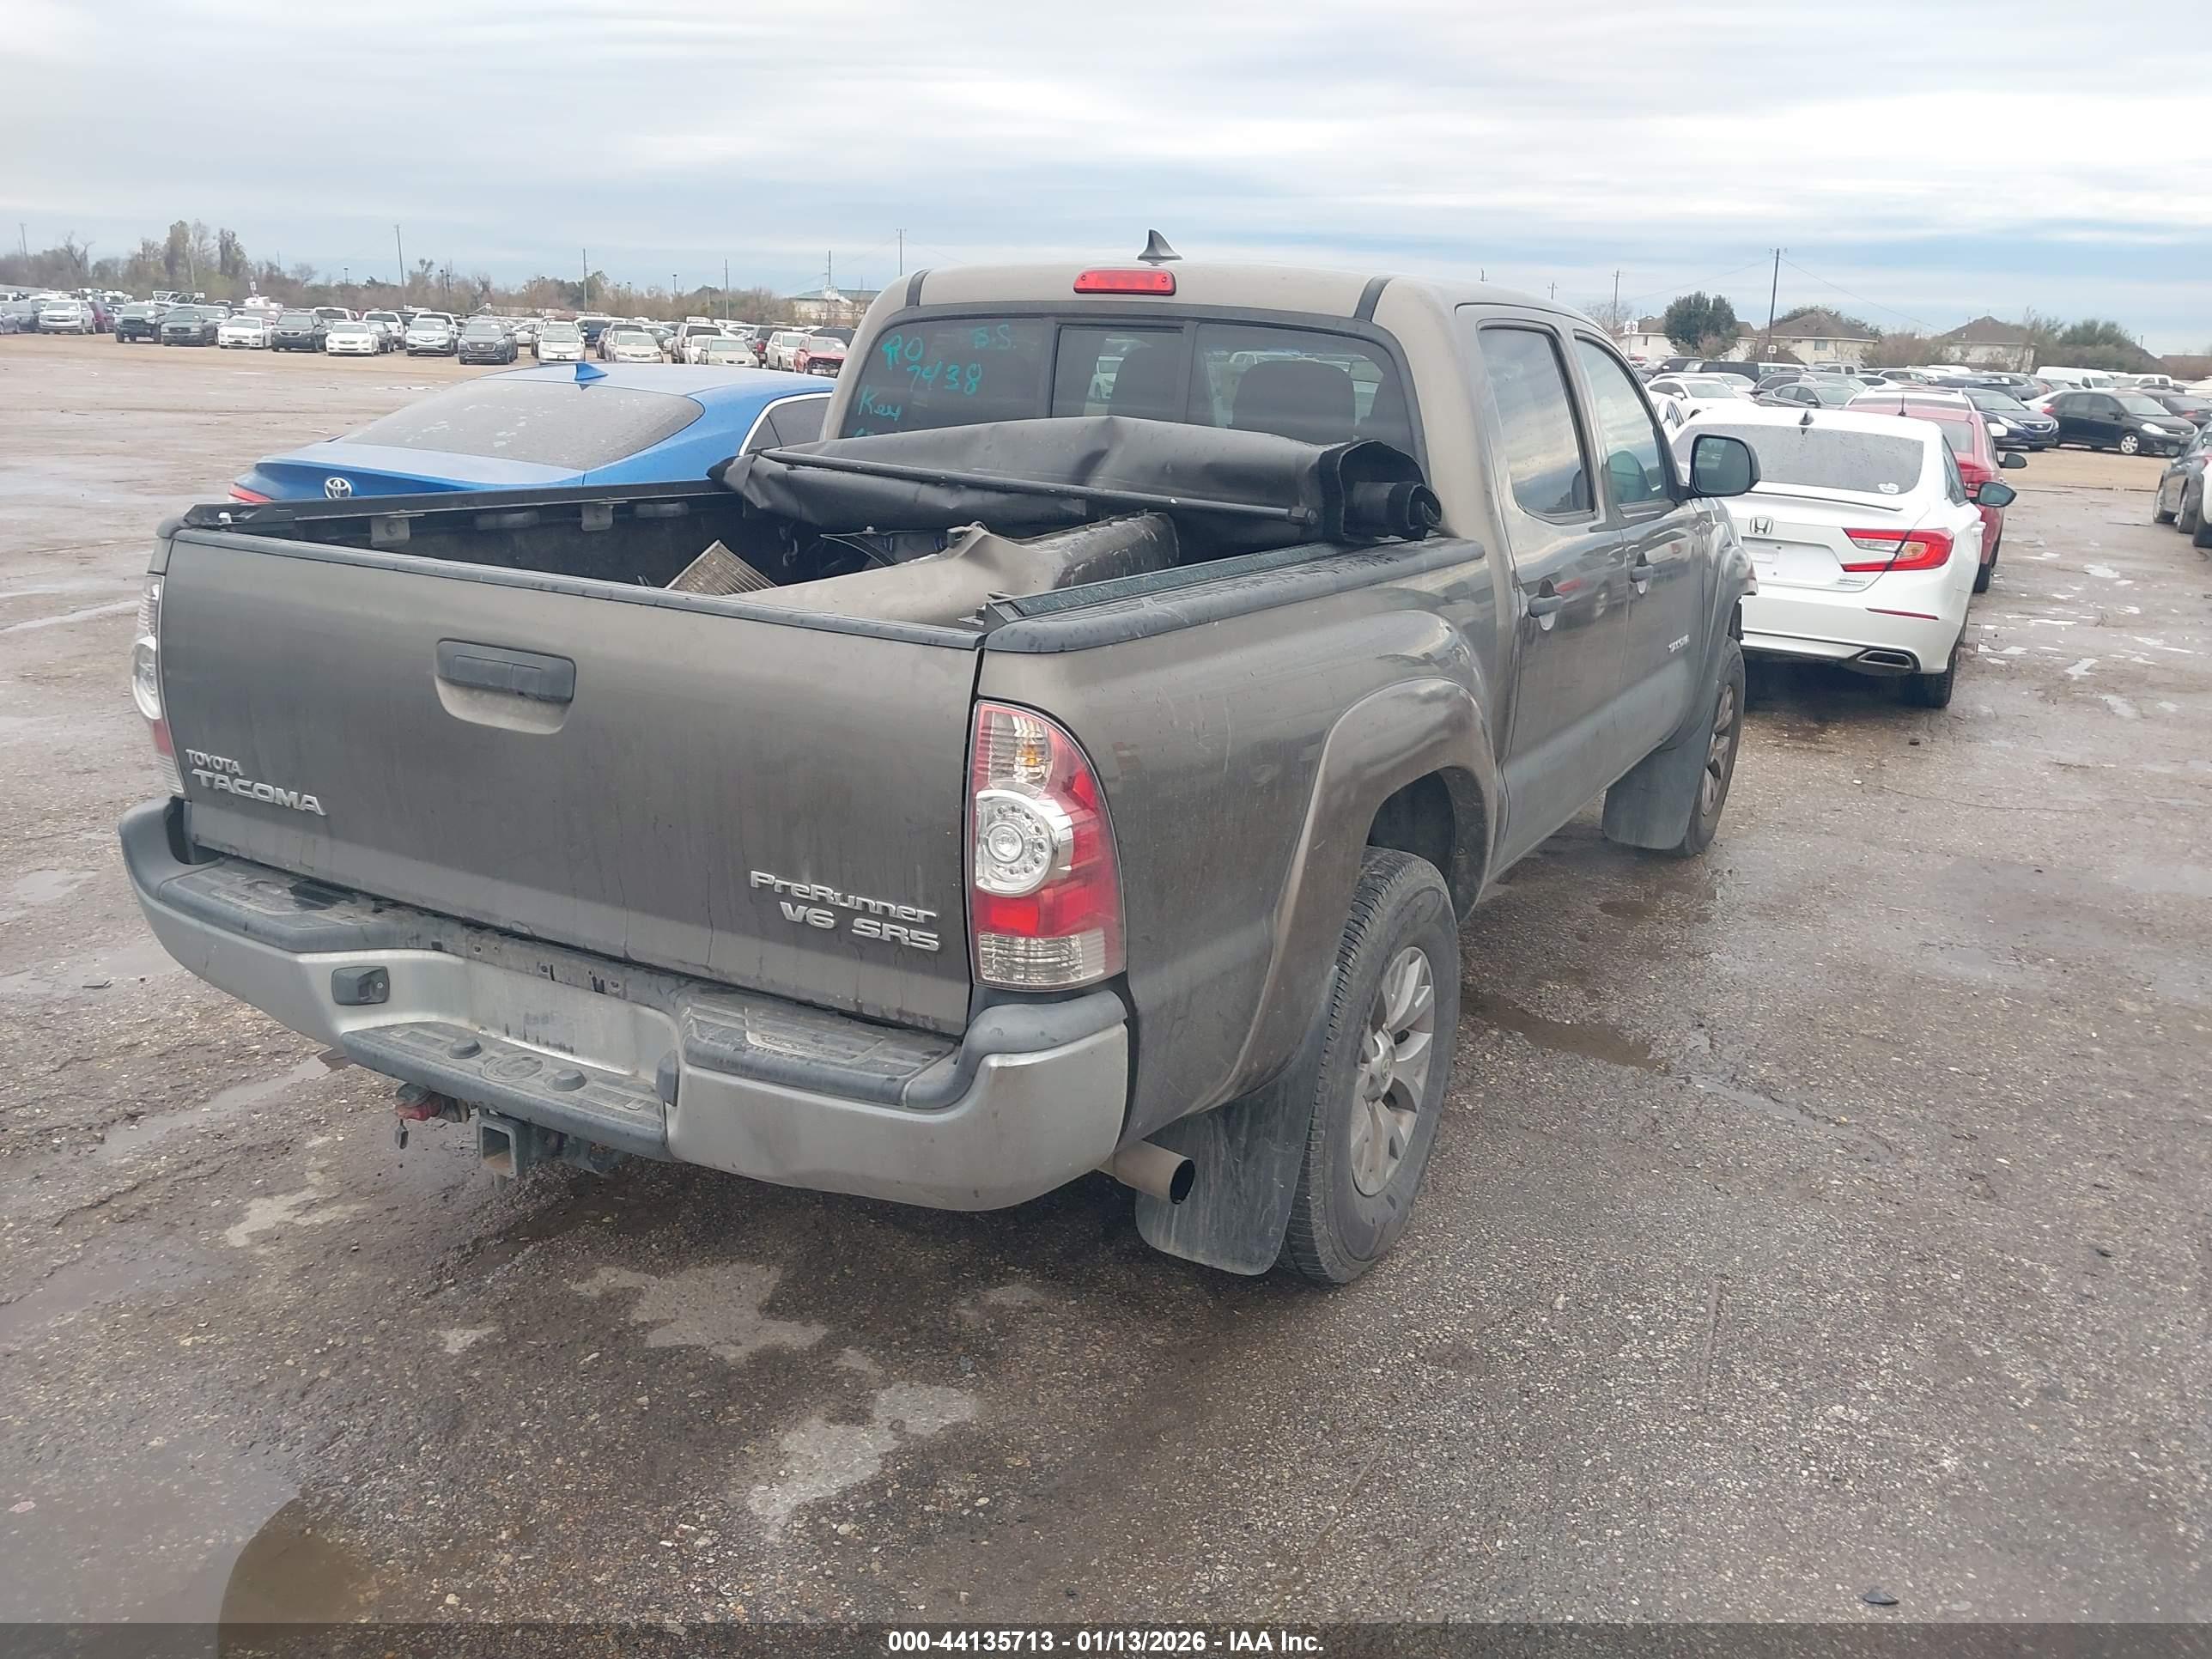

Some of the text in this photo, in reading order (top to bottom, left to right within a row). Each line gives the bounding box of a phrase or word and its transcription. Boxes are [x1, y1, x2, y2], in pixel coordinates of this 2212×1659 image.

[907, 361, 982, 395] 7438
[859, 385, 902, 422] Key
[185, 749, 244, 776] TOYOTA
[191, 769, 326, 816] TACOMA
[750, 870, 938, 923] PreRunner
[780, 901, 940, 951] V6 SR5
